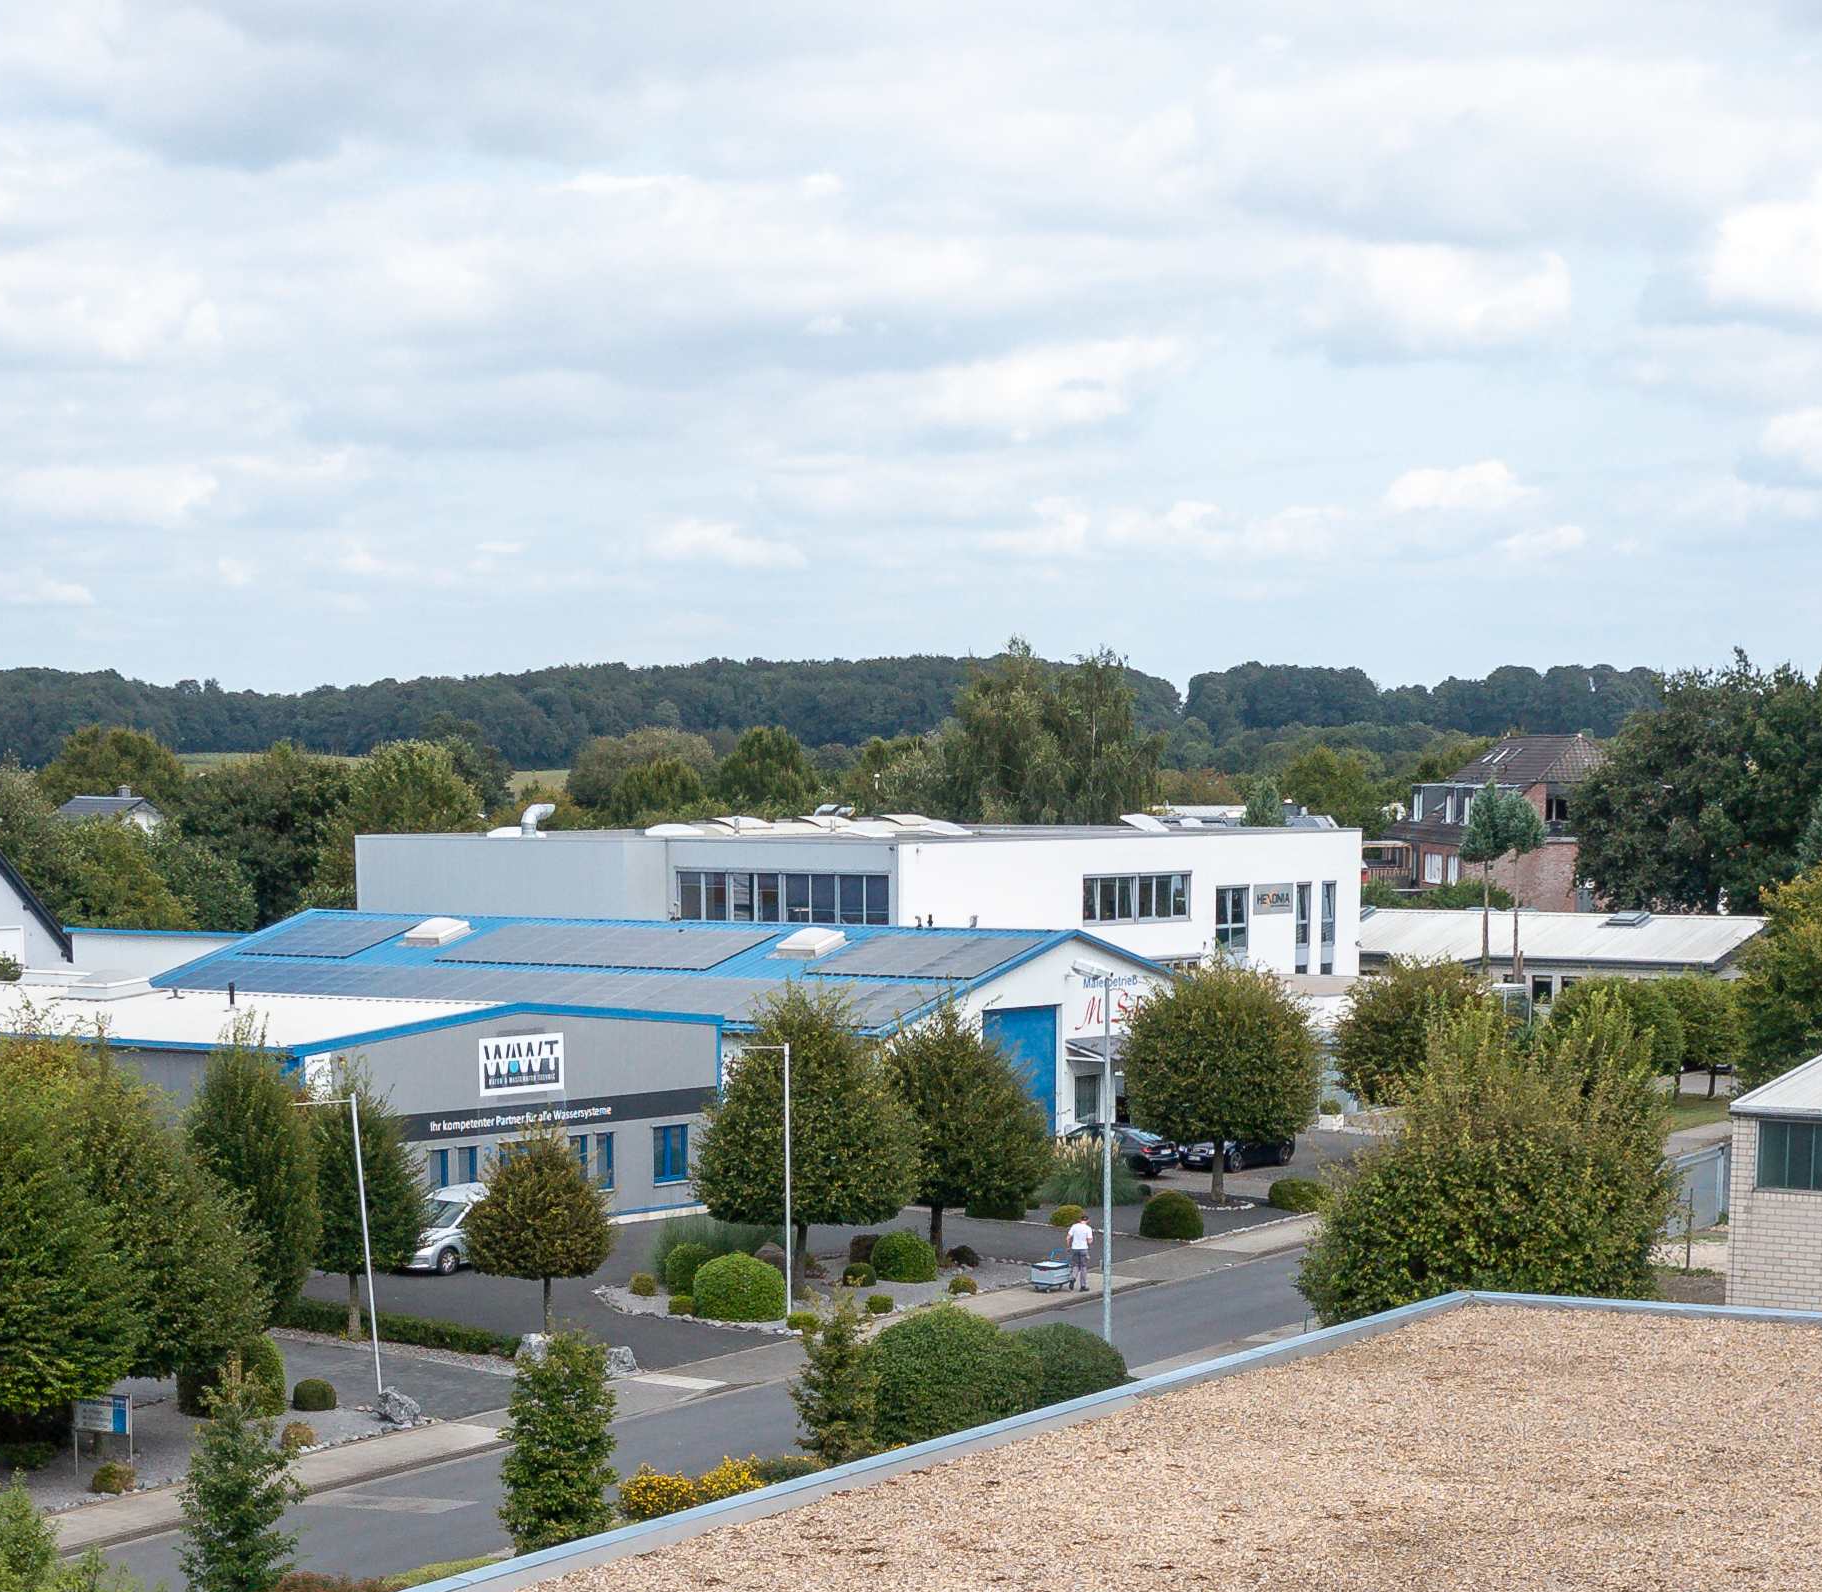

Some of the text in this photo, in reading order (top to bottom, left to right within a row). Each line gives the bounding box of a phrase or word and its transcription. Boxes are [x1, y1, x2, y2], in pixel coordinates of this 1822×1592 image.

[1257, 891, 1290, 905] HEXONIA
[1083, 975, 1138, 988] Malebetrieb
[430, 1120, 441, 1132] Ihr
[442, 1117, 495, 1132] kompetenter
[496, 1114, 525, 1126] Partner
[553, 1105, 612, 1121] Wassersysteme
